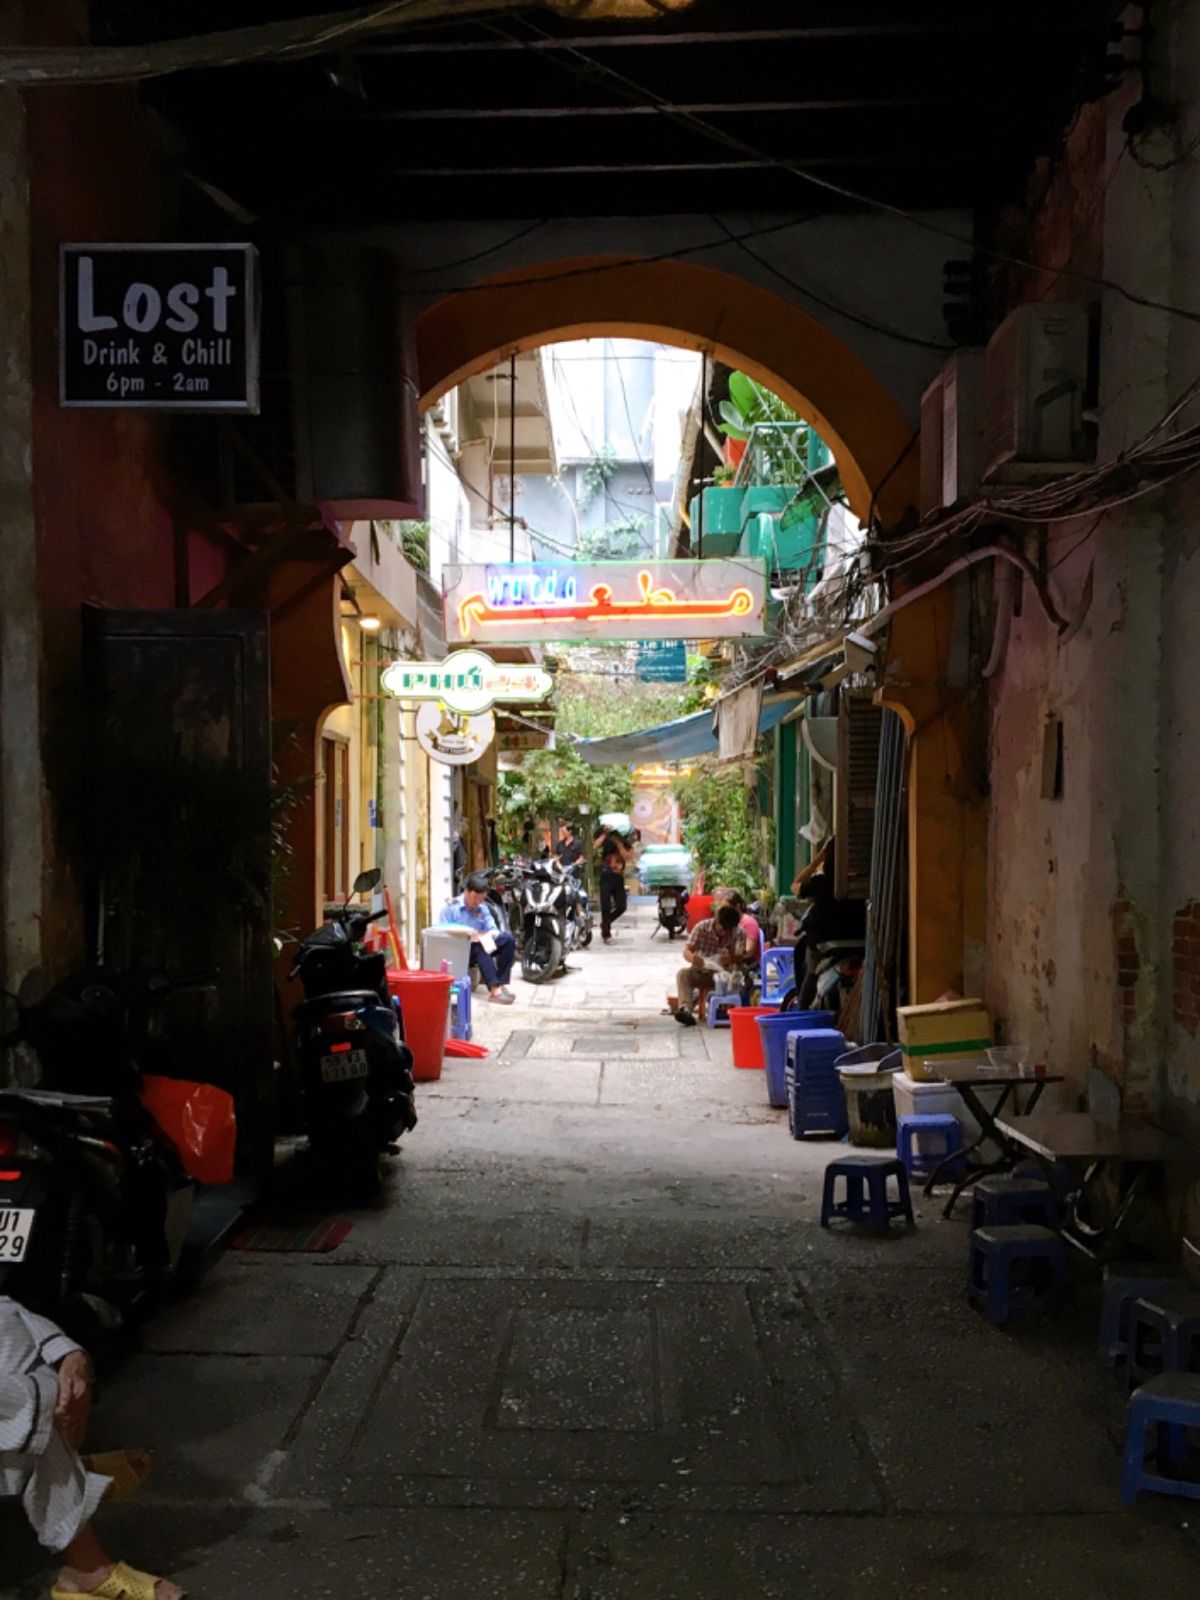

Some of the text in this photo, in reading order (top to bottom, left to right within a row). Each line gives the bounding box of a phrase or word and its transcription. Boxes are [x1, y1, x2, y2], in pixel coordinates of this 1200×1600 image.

[78, 256, 237, 333] Lost
[83, 338, 231, 365] Drink & Chill
[106, 372, 145, 397] 6pm
[172, 372, 209, 392] 2am
[0, 1235, 24, 1257] 29
